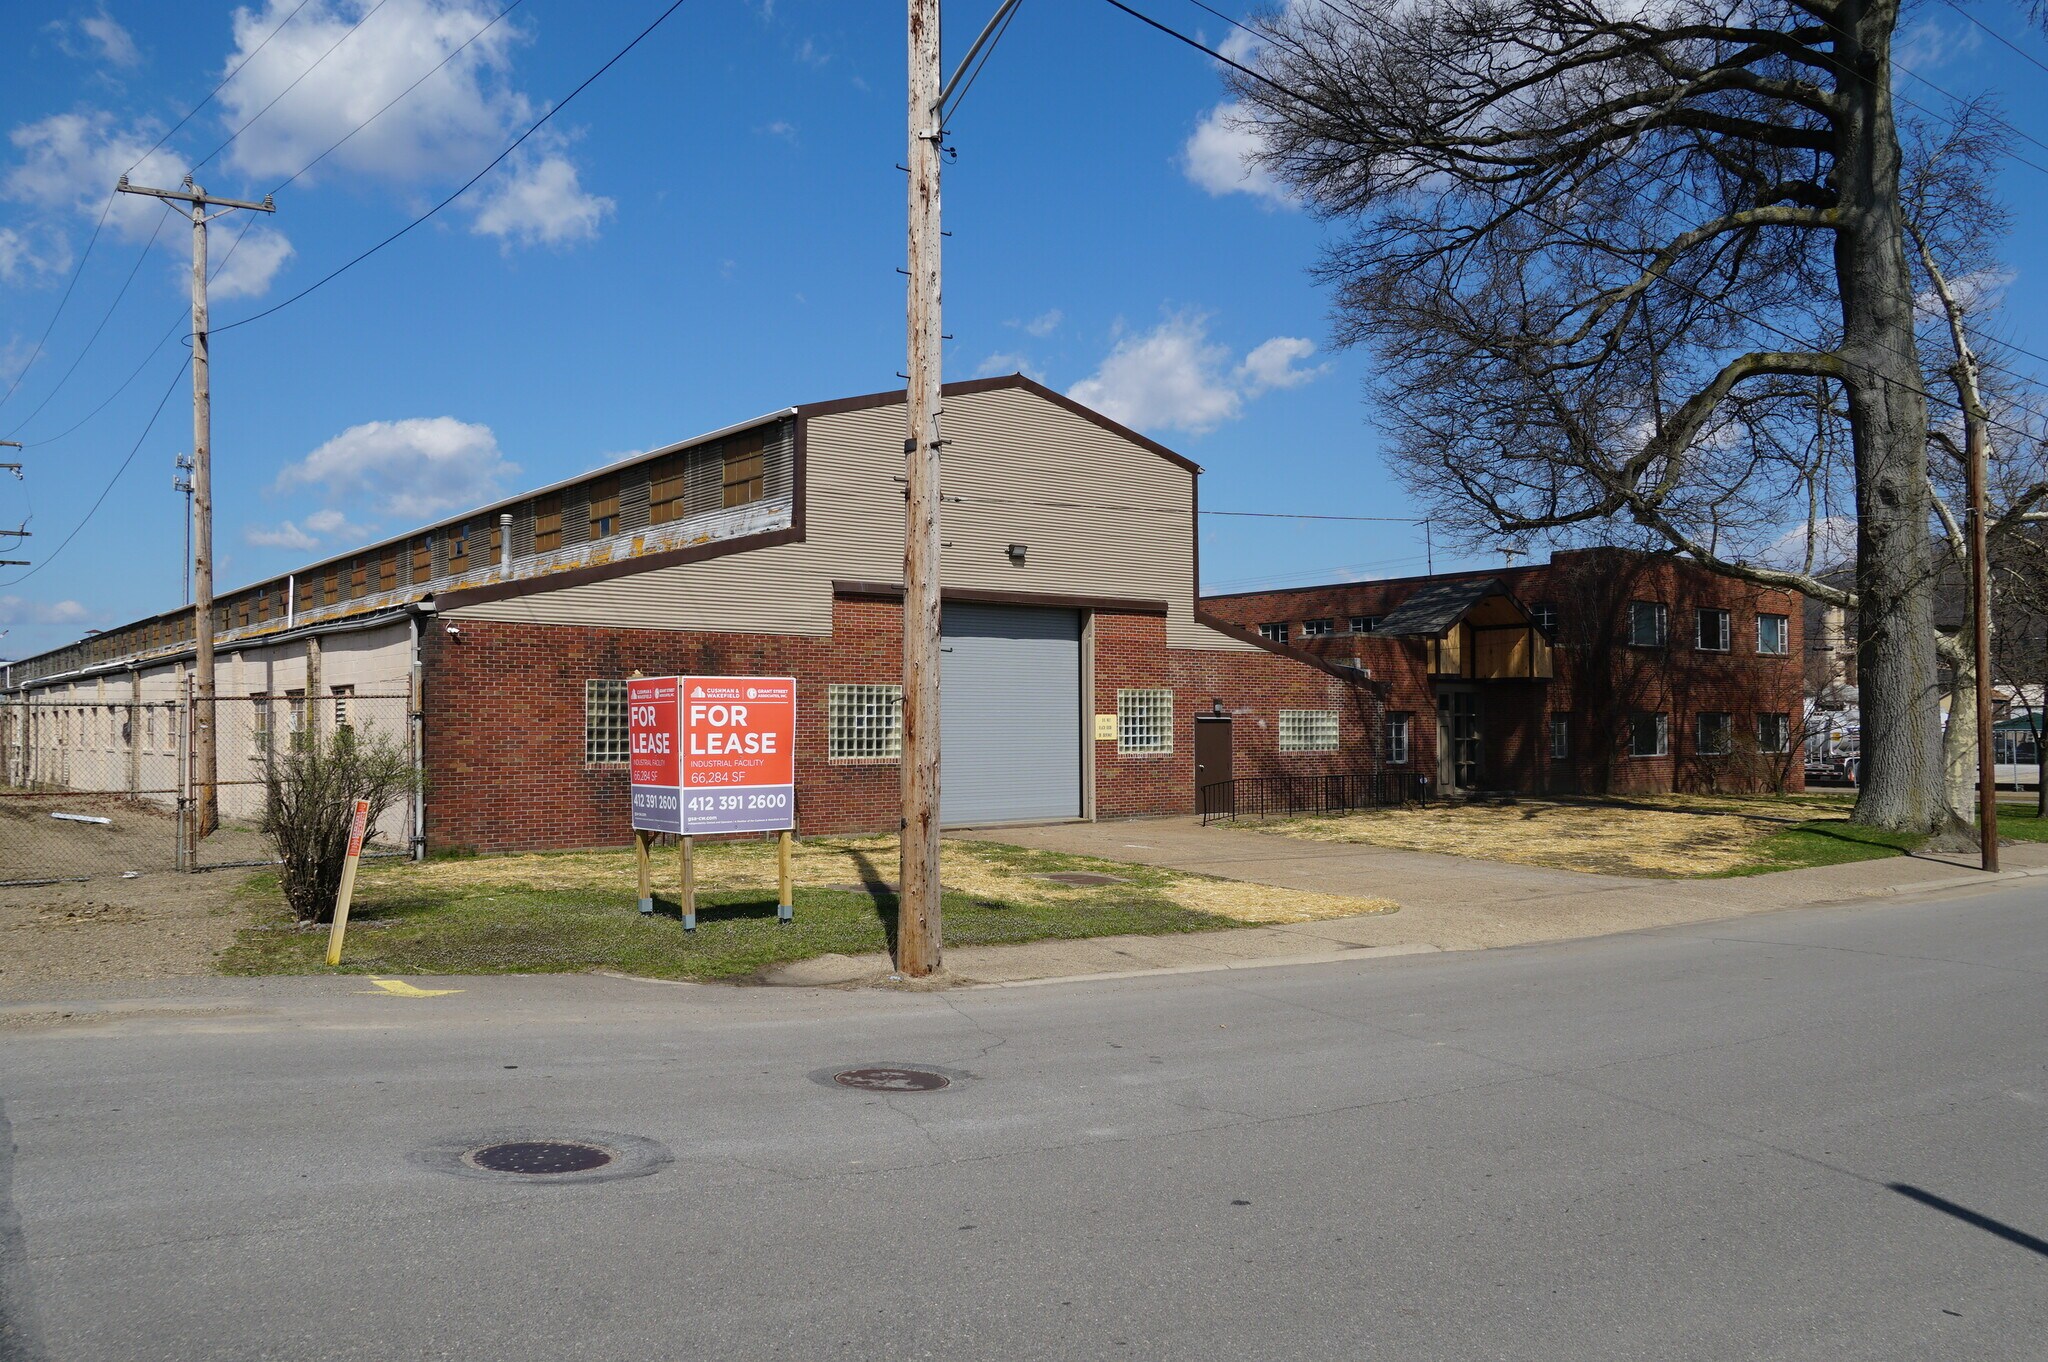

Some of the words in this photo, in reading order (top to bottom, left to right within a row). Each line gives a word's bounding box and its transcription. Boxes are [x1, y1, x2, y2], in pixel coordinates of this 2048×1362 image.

[631, 706, 657, 727] FOR
[691, 705, 748, 727] FOR
[632, 732, 670, 754] LEASE
[691, 732, 777, 755] LEASE
[690, 760, 733, 768] INDUSTRIAL
[734, 759, 764, 767] FACILITY
[633, 770, 651, 782] 66,284
[651, 770, 658, 782] SF
[691, 771, 729, 784] 66,284
[731, 771, 746, 783] SF
[634, 793, 645, 808] 412
[645, 794, 658, 809] 391
[659, 795, 677, 810] 2600
[688, 796, 714, 811] 412
[719, 795, 743, 810] 391
[748, 793, 787, 809] 2600
